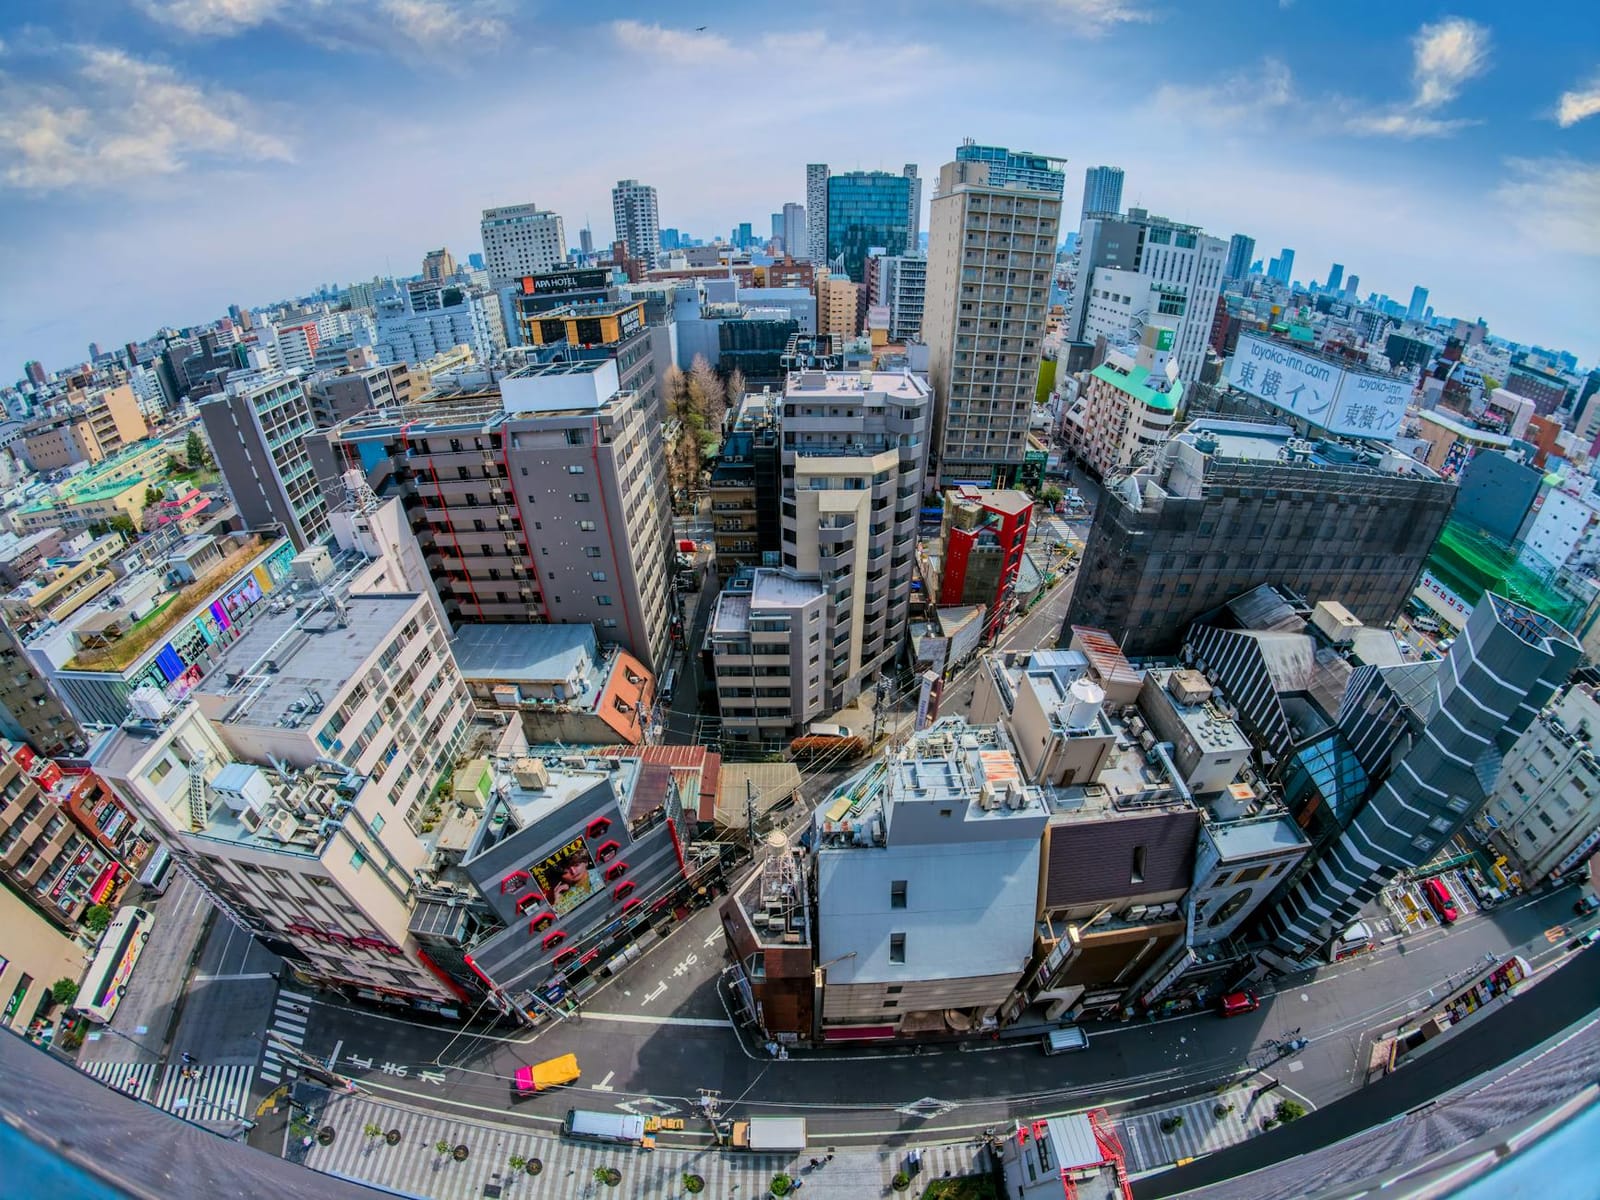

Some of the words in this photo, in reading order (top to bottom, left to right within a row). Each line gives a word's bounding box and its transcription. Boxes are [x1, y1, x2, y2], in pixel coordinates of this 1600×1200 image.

[535, 280, 551, 288] APA
[552, 277, 578, 287] HOTEL
[1251, 342, 1330, 382] toyoko-inn.com
[1236, 361, 1329, 415] 東横イン
[1358, 377, 1402, 395] toyoko-inn
[1342, 402, 1401, 431] 東横イン
[531, 839, 583, 875] KAITO
[1414, 836, 1433, 849] 75
[640, 924, 725, 1006] 止まれ
[346, 1054, 446, 1086] 止まれ
